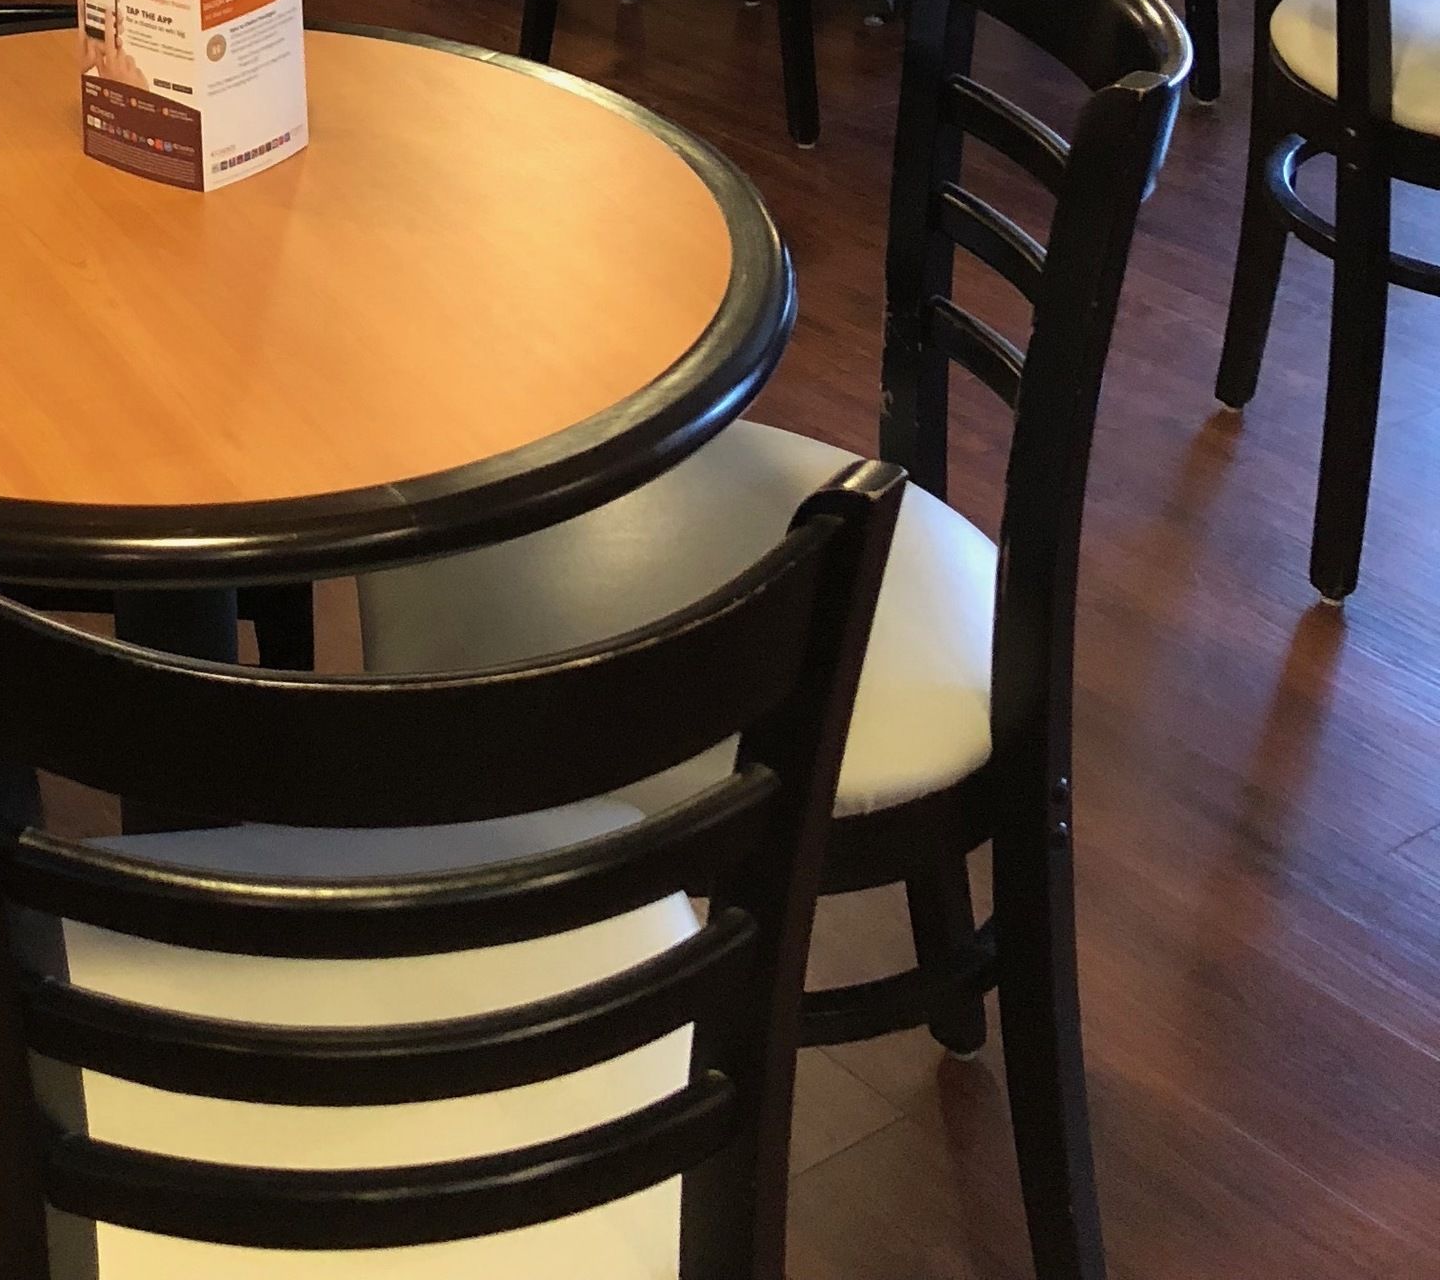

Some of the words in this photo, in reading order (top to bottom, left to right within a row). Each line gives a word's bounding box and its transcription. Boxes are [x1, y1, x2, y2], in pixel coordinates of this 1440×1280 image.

[126, 5, 139, 15] TAP
[142, 10, 155, 21] THE
[157, 15, 173, 25] APP
